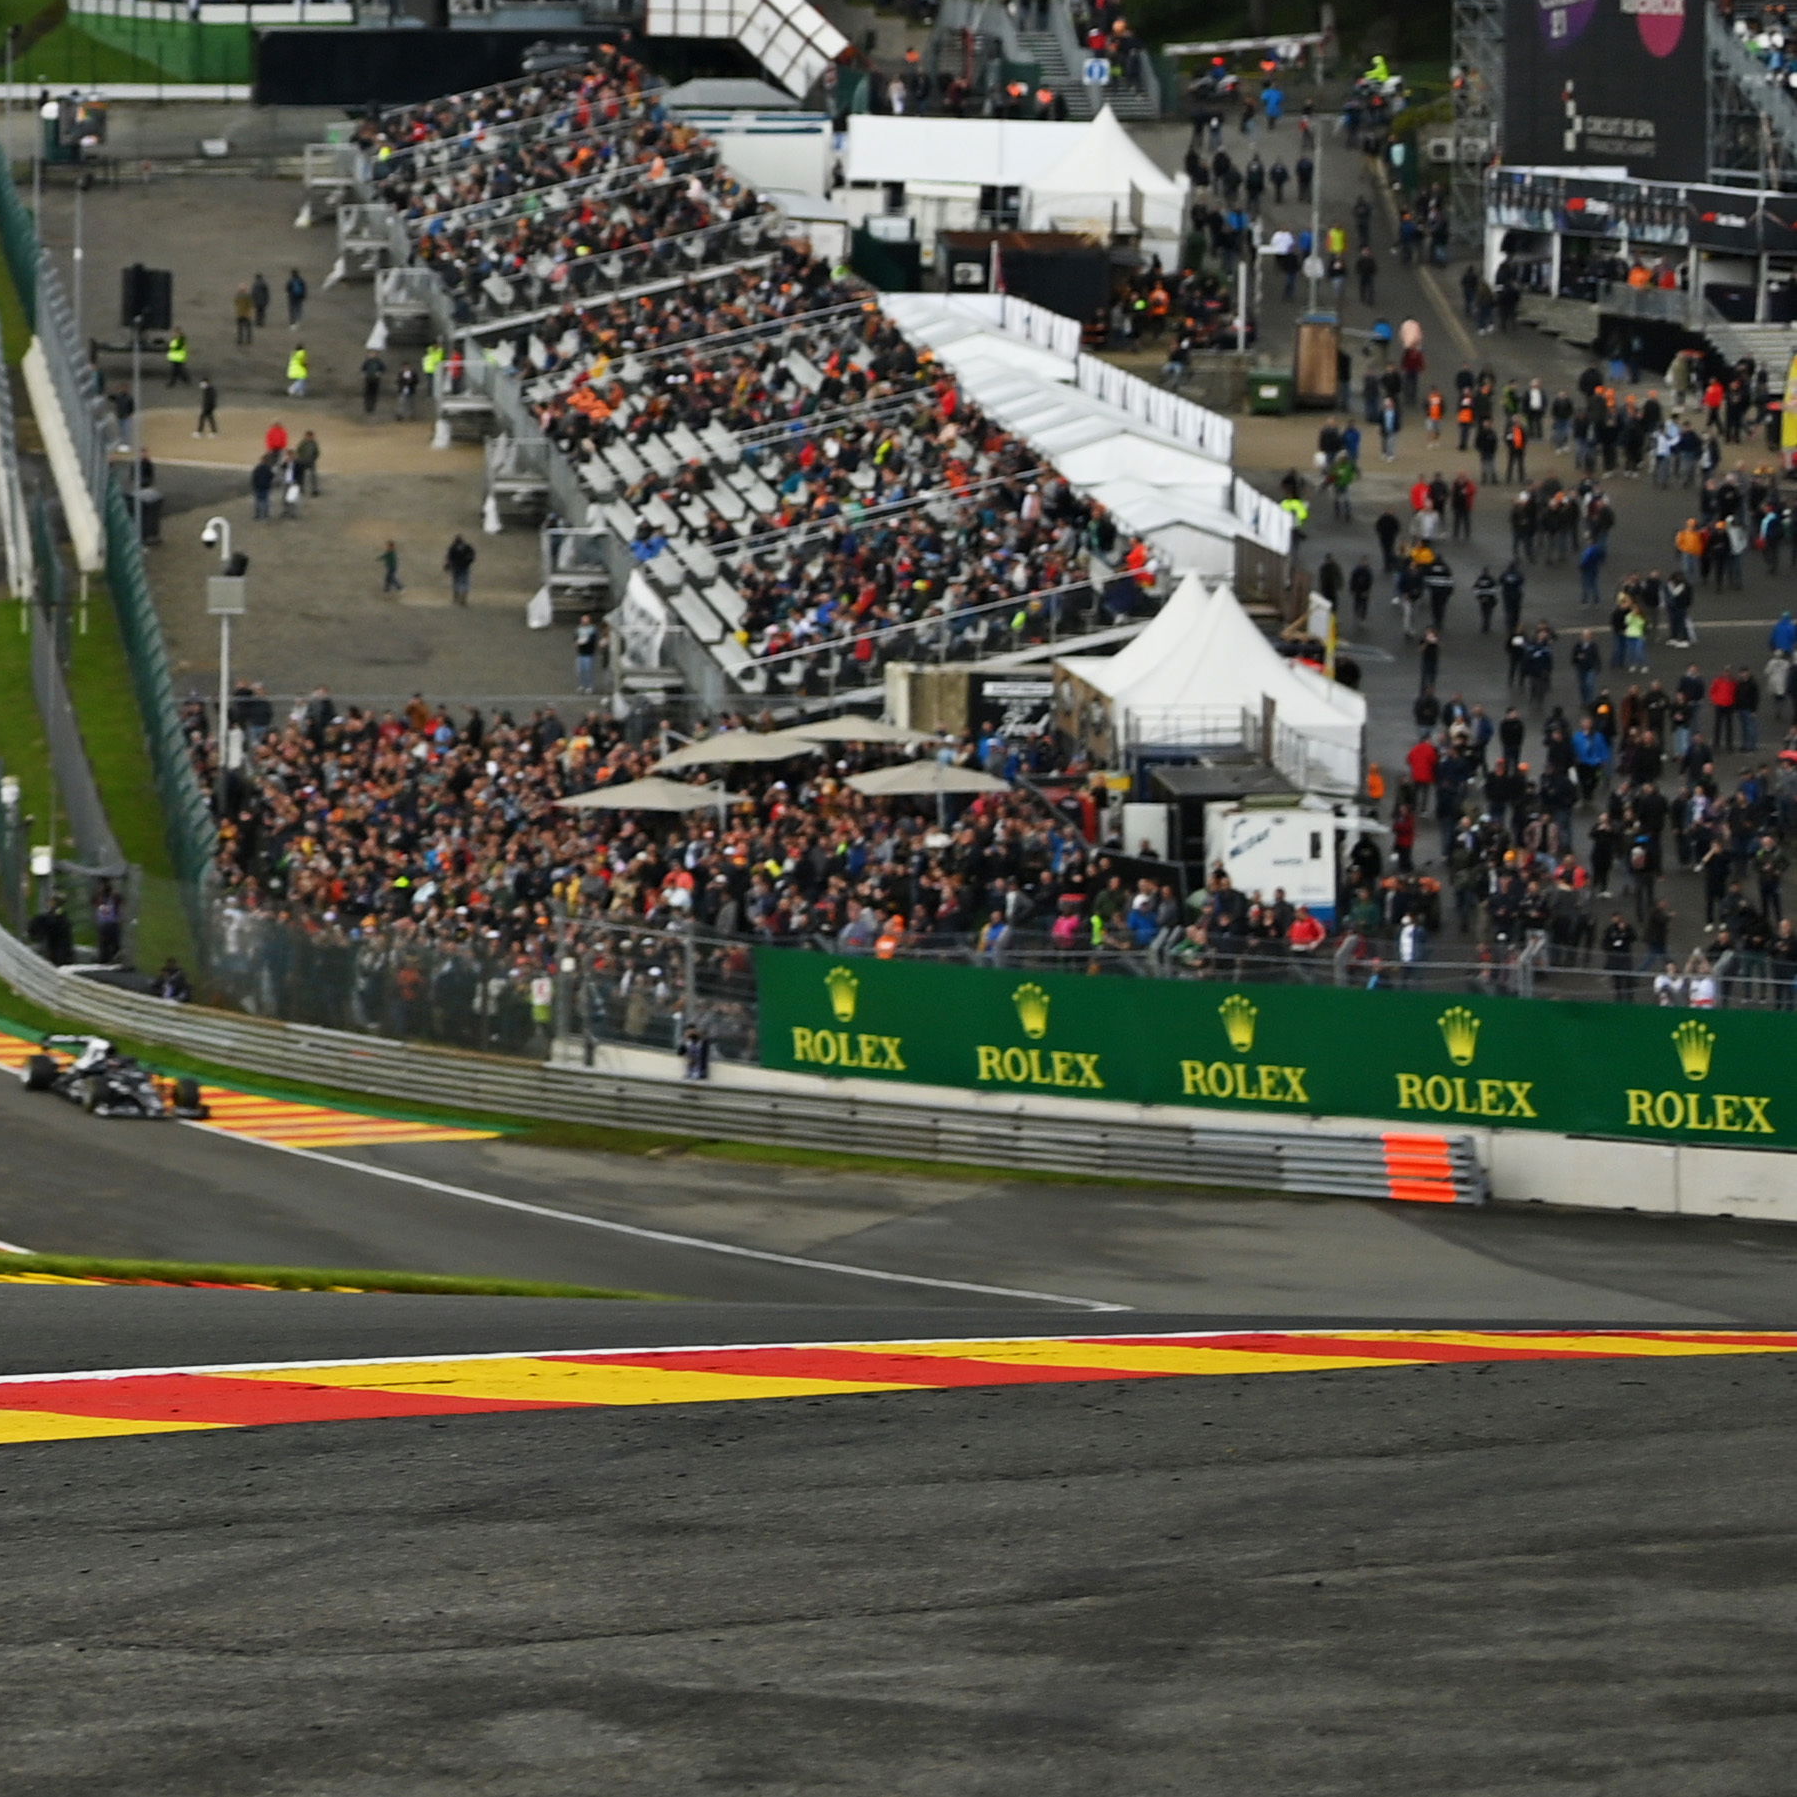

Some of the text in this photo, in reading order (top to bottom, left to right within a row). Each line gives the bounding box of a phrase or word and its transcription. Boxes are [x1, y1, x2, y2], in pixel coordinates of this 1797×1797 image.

[792, 1026, 906, 1072] ROLEX
[976, 1046, 1104, 1090] ROLEX
[1181, 1060, 1308, 1104] ROLEX
[1396, 1074, 1537, 1118] ROLEX
[1626, 1089, 1774, 1135] ROLEX
